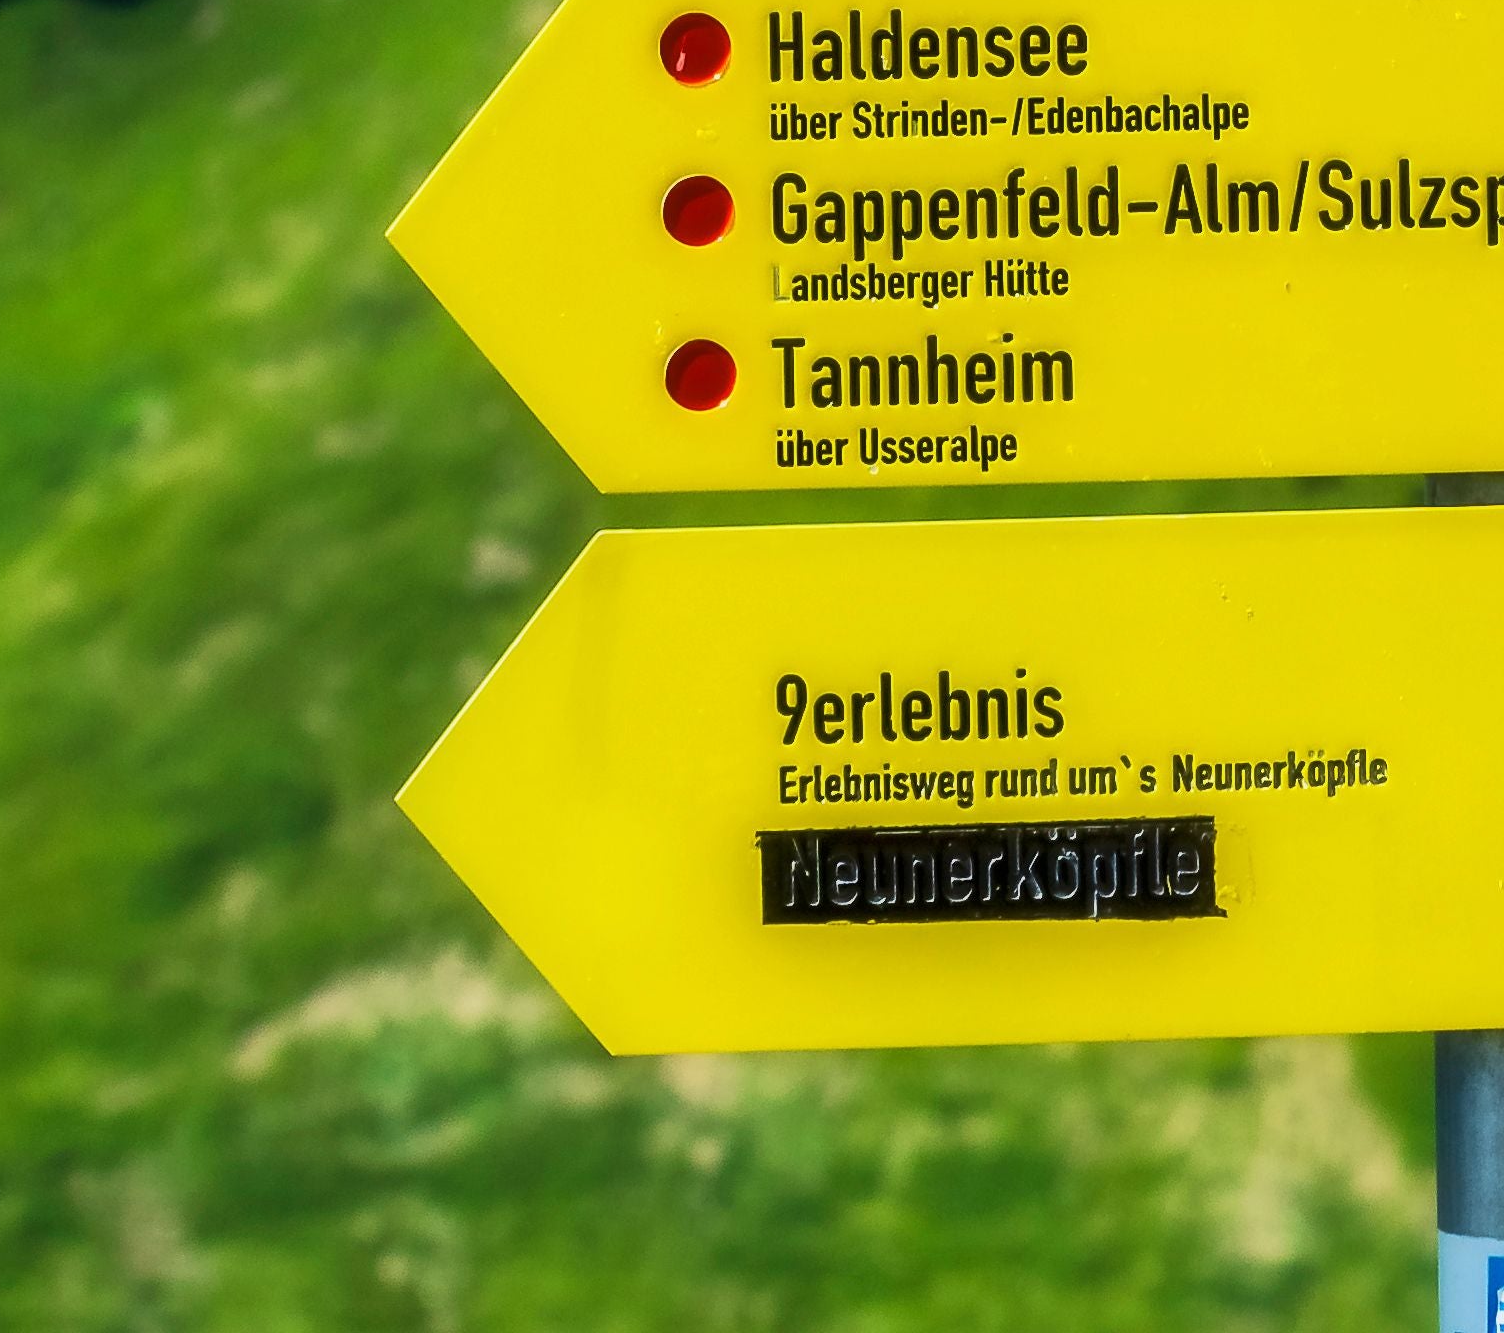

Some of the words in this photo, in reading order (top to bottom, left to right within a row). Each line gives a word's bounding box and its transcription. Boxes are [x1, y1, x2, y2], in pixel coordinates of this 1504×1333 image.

[768, 8, 1088, 83] Haldensee
[770, 102, 843, 141] über
[852, 93, 1250, 141] Strinden-/Edenbachalpe
[773, 262, 974, 309] Landsberger
[984, 258, 1069, 297] Hütte
[771, 332, 1074, 409] Tannheim
[776, 429, 849, 468] über
[859, 424, 1018, 469] Usseralpe
[776, 668, 1065, 746] 9erlebnis
[779, 762, 975, 809] Erlebnisweg
[985, 757, 1059, 798] rund
[1172, 748, 1388, 798] Neunerköpfle
